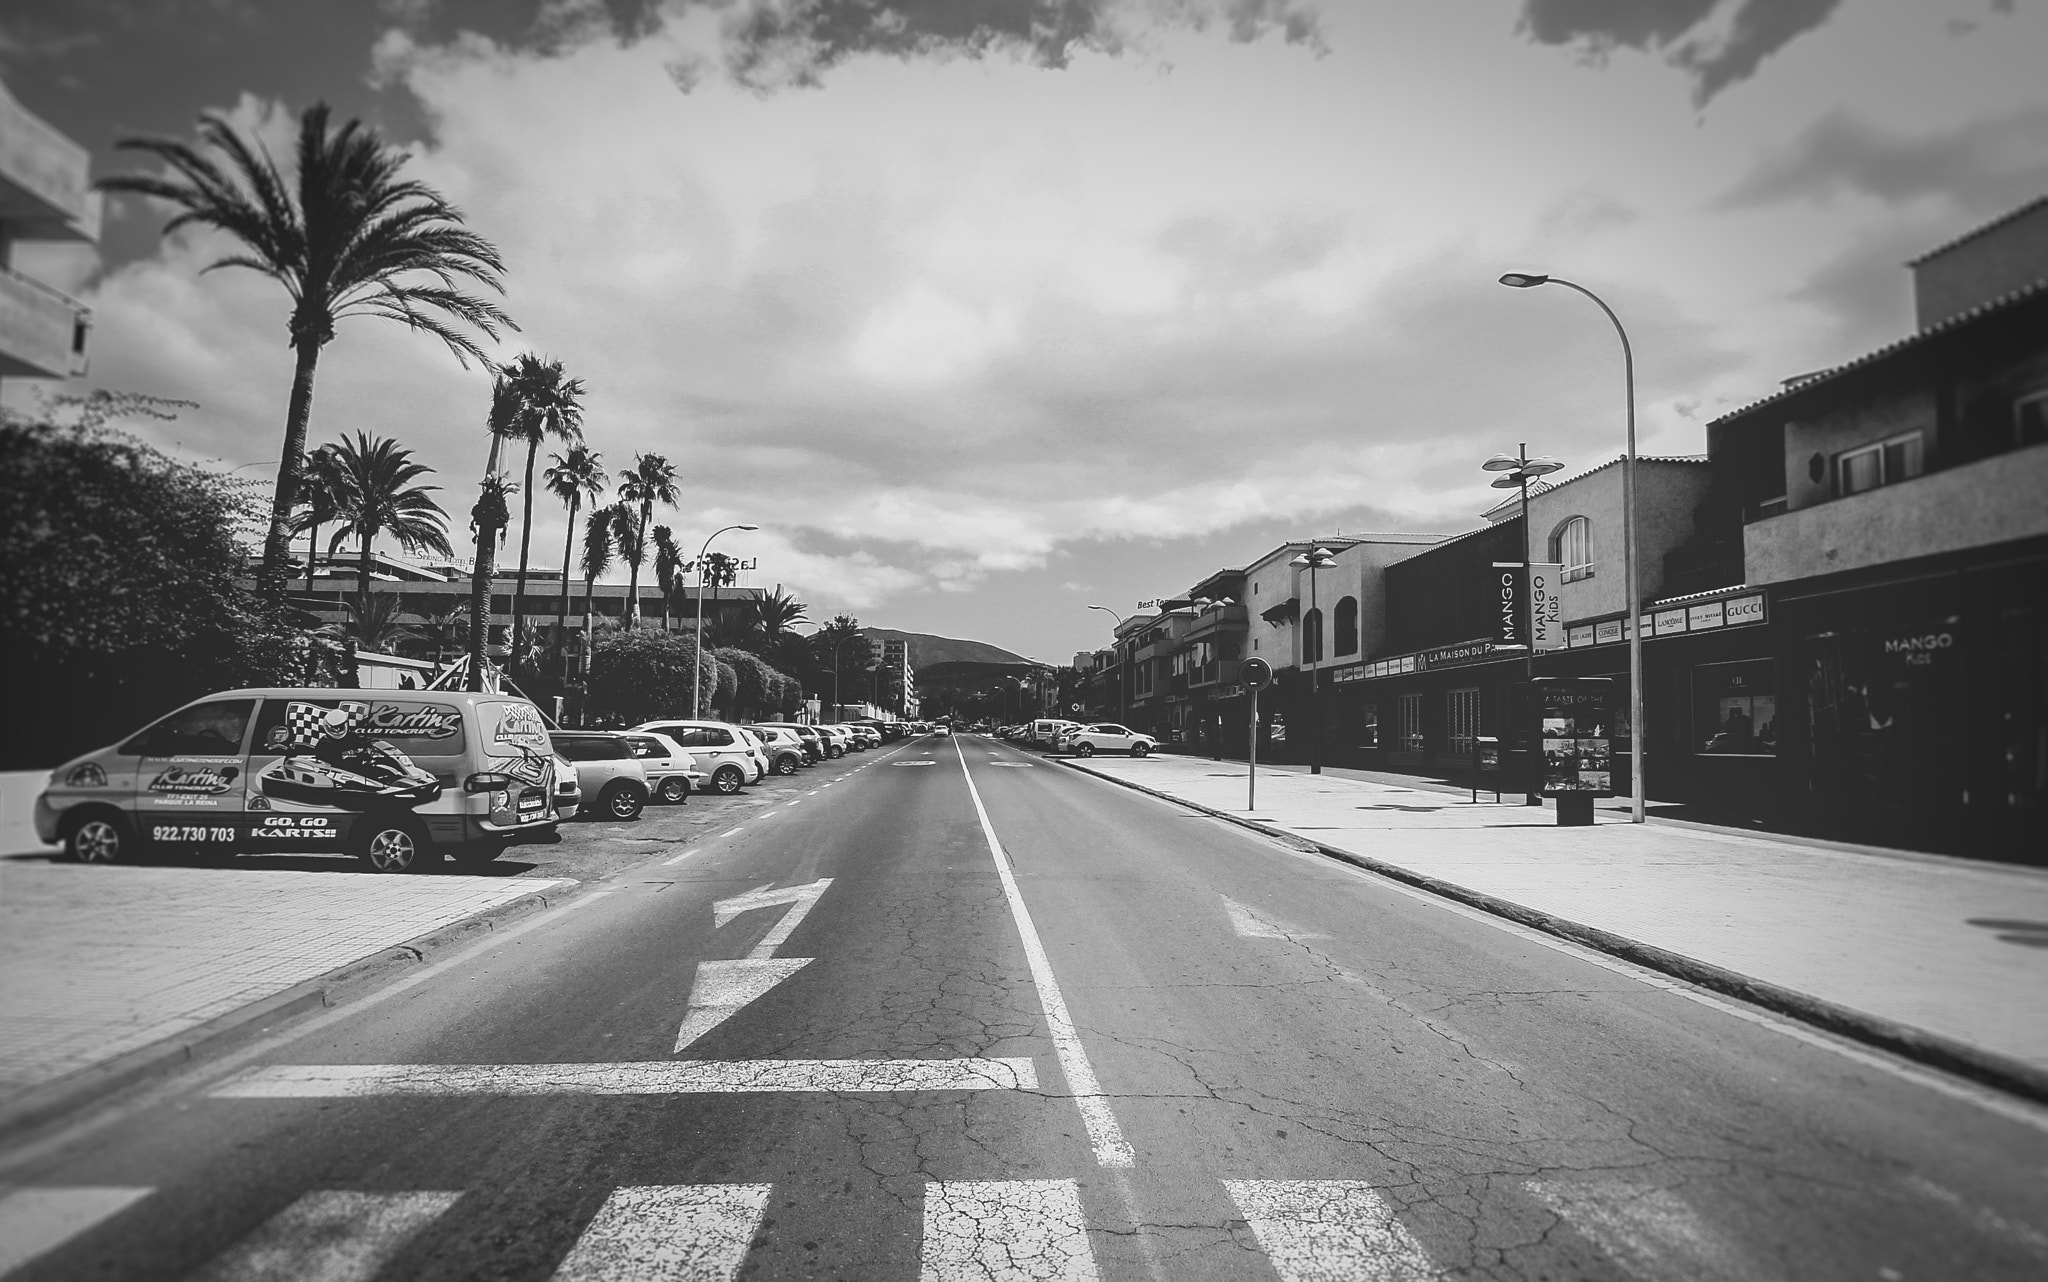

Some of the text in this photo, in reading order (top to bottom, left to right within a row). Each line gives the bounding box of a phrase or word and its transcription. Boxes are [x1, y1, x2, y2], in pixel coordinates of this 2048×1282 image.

[1137, 600, 1154, 609] Best
[1502, 573, 1515, 640] MANGO
[1533, 575, 1547, 641] MANGO
[1727, 602, 1762, 617] GUCCI
[1885, 633, 1953, 653] MANGO
[1429, 653, 1439, 662] LA
[1440, 648, 1470, 661] MAISON
[1472, 645, 1483, 656] DU
[369, 704, 461, 738] Karting
[157, 766, 232, 794] Karting
[264, 817, 329, 827] GO, GO
[153, 826, 235, 843] 922.730 703
[251, 828, 338, 839] KARTS!!
